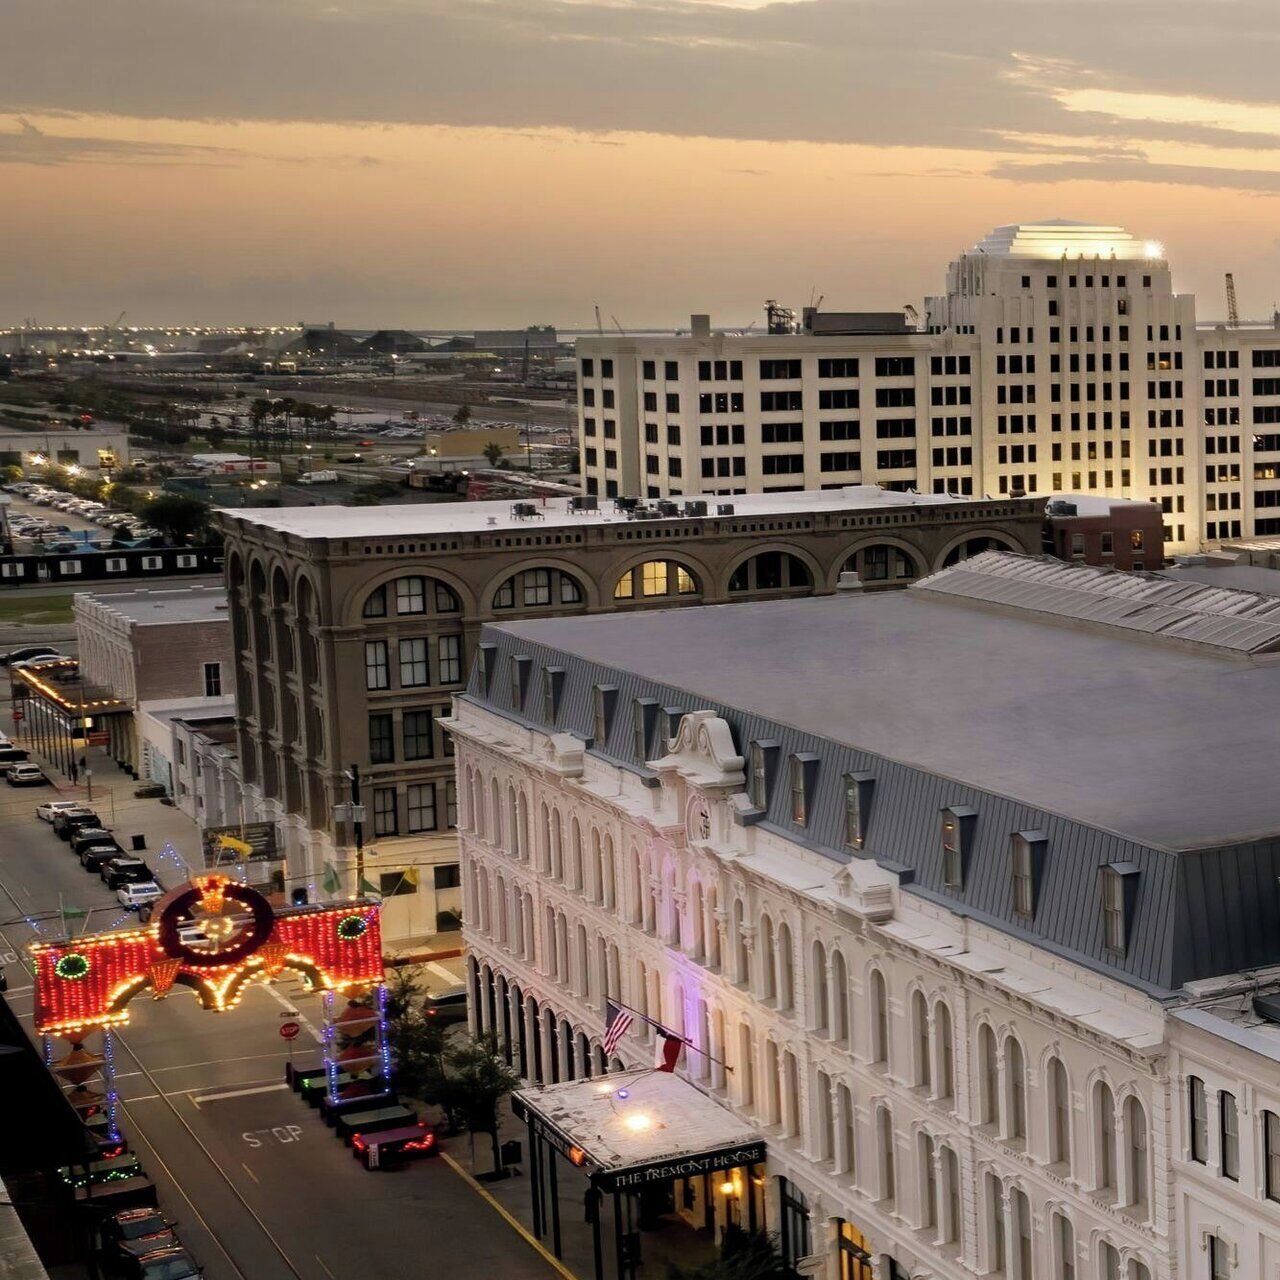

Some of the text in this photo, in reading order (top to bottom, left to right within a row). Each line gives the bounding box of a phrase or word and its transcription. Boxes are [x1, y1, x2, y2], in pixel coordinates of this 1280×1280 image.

[281, 1026, 298, 1035] STOP
[242, 1125, 303, 1148] STOP
[616, 1149, 760, 1187] THE TREMONT HOUSE
